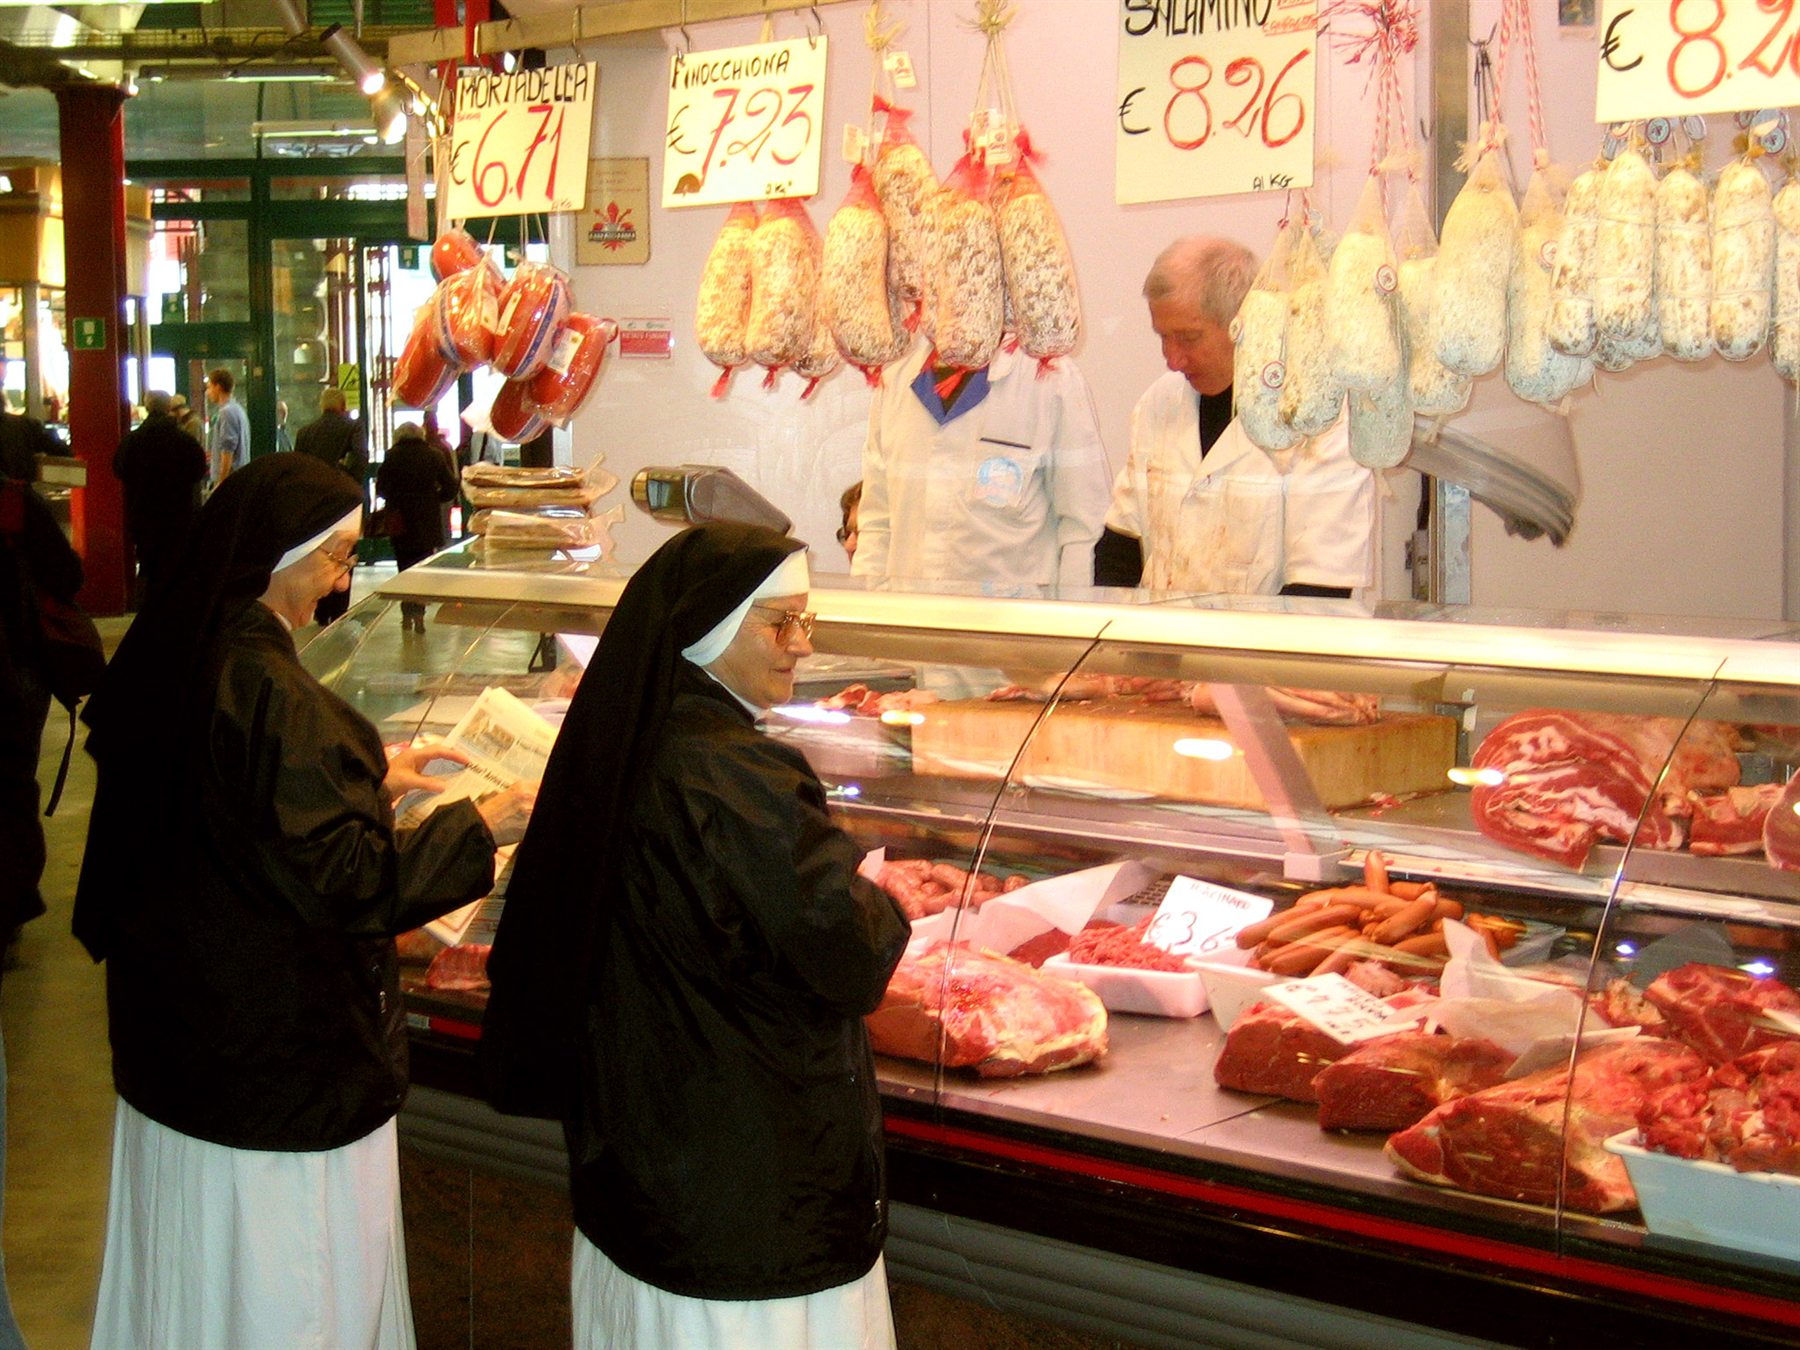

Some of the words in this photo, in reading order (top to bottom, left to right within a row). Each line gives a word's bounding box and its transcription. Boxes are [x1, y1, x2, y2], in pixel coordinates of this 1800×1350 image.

[1125, 0, 1271, 37] SALAMINO
[1600, 8, 1643, 72] €
[1667, 0, 1800, 99] 8.2
[459, 63, 588, 111] MORTADELLA
[671, 49, 790, 89] FINOCCHIONA
[1119, 87, 1151, 135] €
[1164, 48, 1311, 151] 8.26
[450, 140, 471, 186] €
[472, 105, 566, 208] 6.71
[666, 104, 696, 154] €
[701, 83, 815, 187] 7.23
